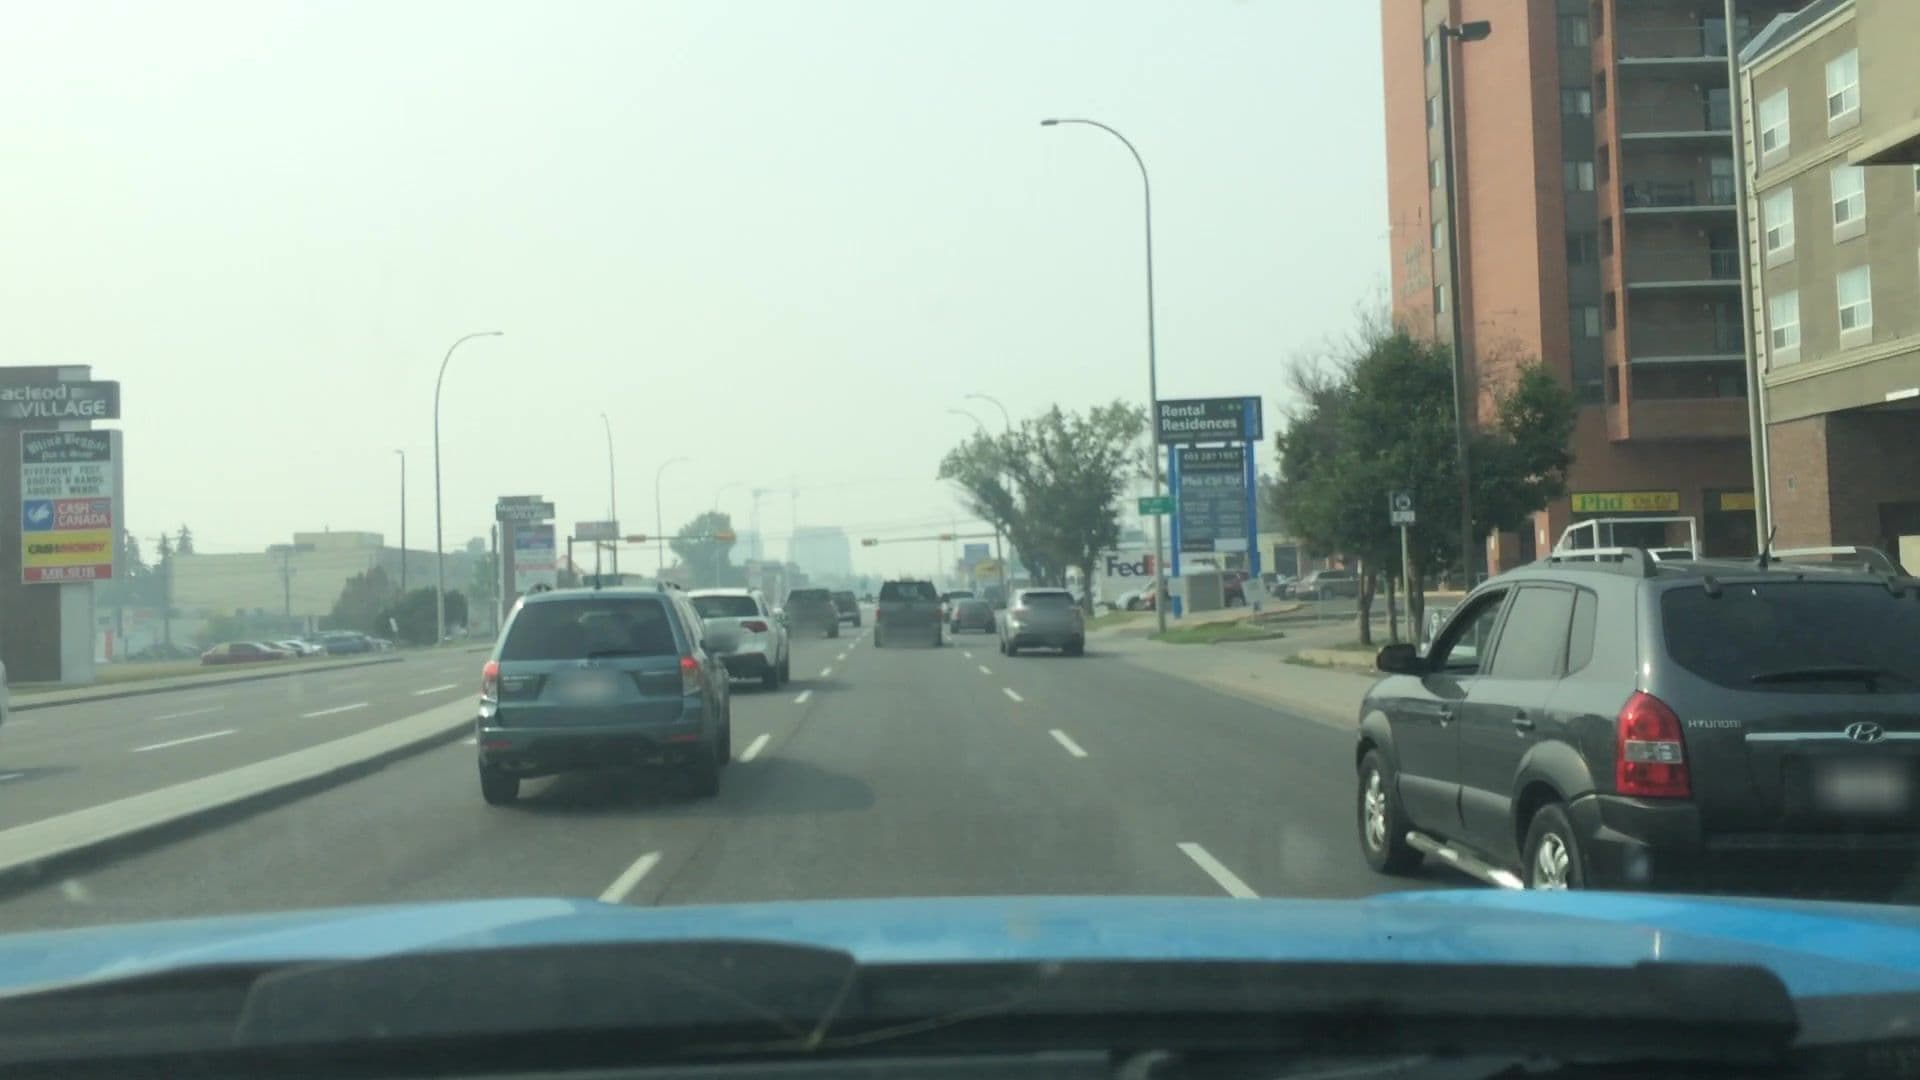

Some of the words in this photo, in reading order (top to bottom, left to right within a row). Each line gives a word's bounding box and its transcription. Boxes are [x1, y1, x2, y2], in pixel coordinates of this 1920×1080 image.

[18, 400, 105, 417] VILLAGE
[1161, 403, 1206, 417] Rental
[1162, 418, 1238, 432] Residences
[58, 503, 90, 514] CASH
[58, 512, 108, 527] CANADA
[1107, 555, 1164, 577] FedE
